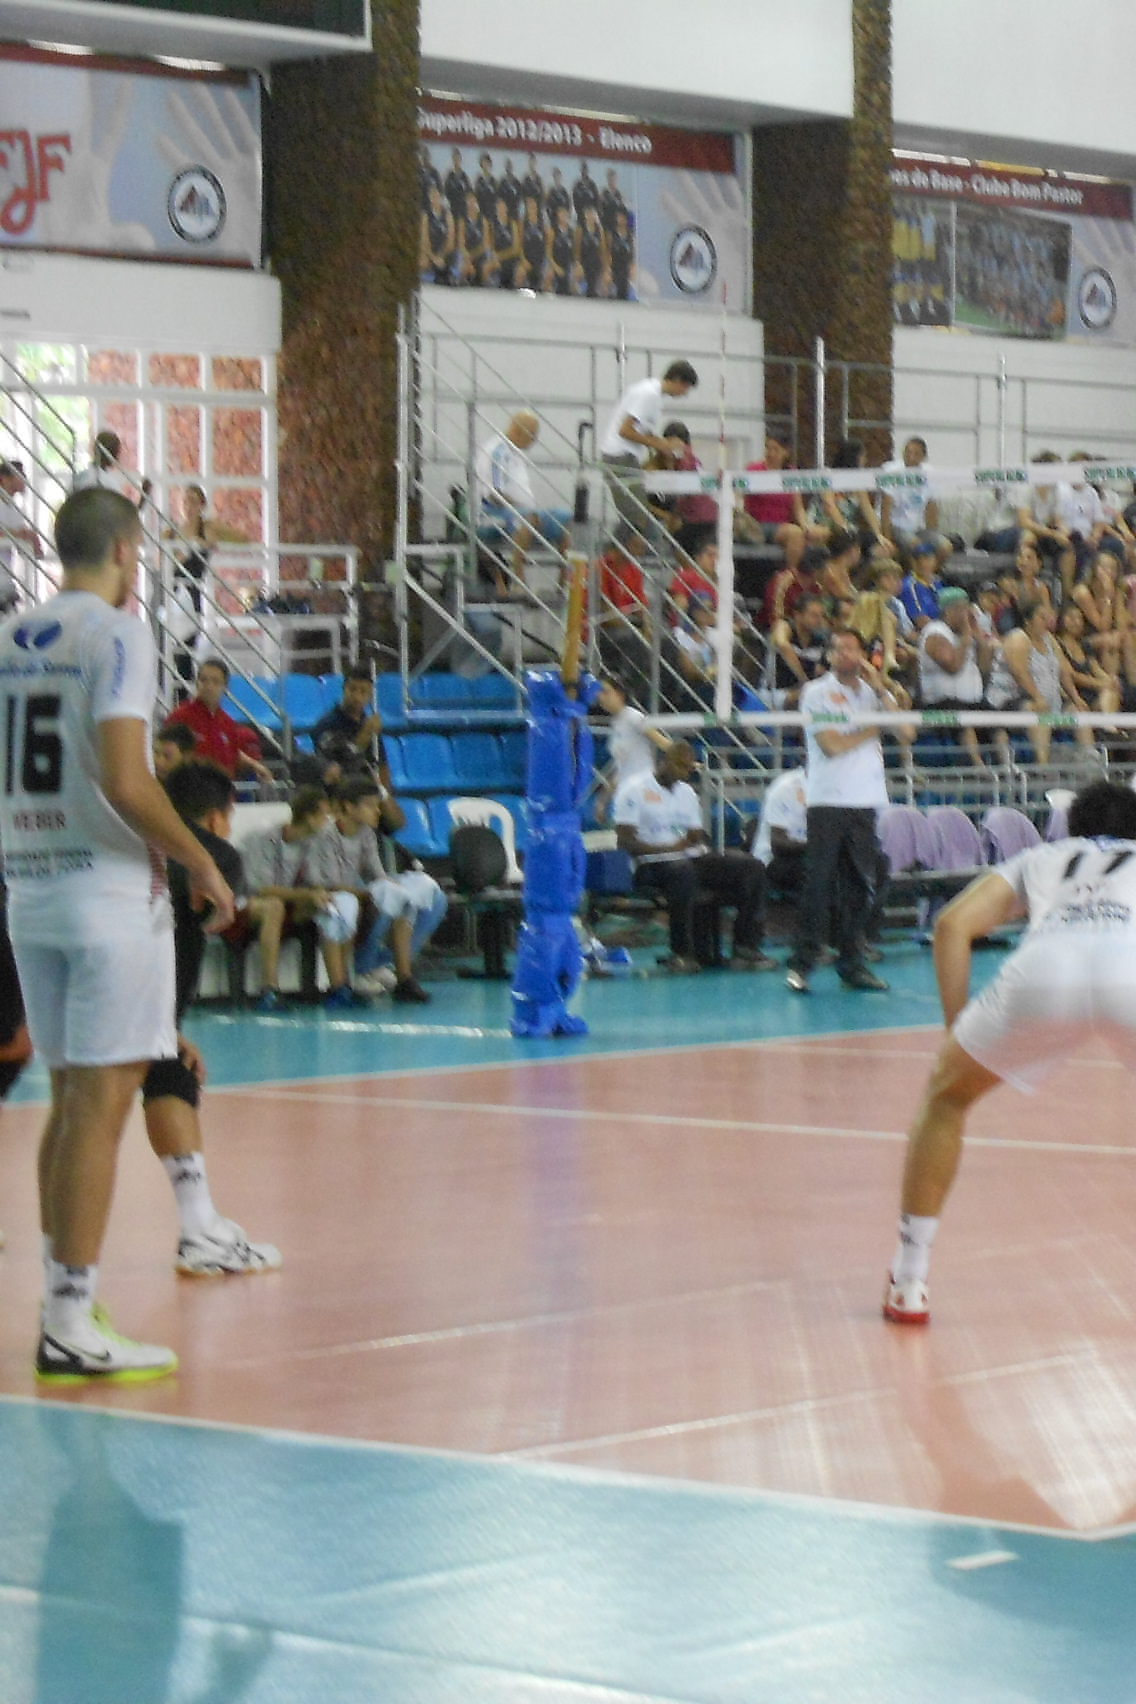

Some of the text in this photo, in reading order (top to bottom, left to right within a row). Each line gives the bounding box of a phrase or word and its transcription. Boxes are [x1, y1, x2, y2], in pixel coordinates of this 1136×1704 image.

[495, 115, 583, 147] 2012/2013
[6, 693, 63, 797] 16
[1063, 849, 1134, 880] 17
